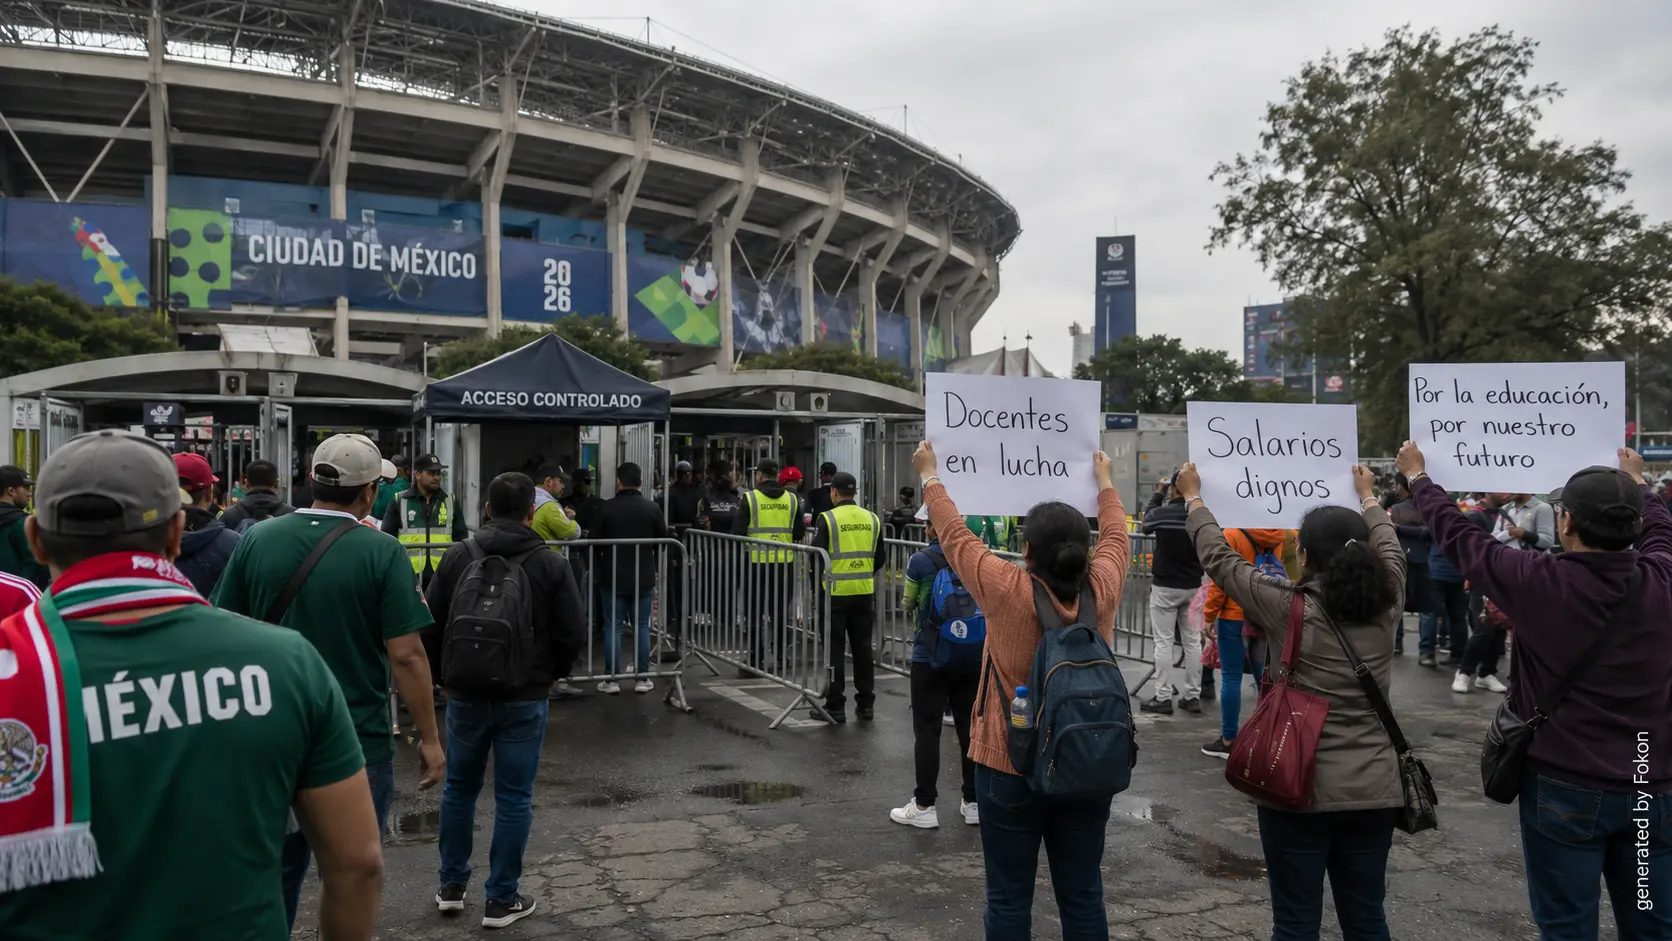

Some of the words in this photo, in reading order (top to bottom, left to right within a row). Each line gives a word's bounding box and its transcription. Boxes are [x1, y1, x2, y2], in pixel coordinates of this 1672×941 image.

[248, 234, 344, 267] CIUDAD
[352, 241, 383, 271] DE
[390, 242, 476, 279] MÉXICO
[543, 258, 571, 286] 20
[543, 284, 571, 312] 26
[460, 390, 529, 407] ACCESO
[533, 392, 642, 409] CONTROLADO
[1414, 376, 1444, 404] Por
[1453, 378, 1474, 404] la
[1485, 379, 1609, 410] educación,
[944, 391, 1069, 433] Docentes
[1430, 419, 1467, 443] por
[1482, 412, 1576, 437] nuestro
[1207, 416, 1342, 459] Salarios
[1453, 441, 1535, 468] futuro
[945, 454, 977, 474] en
[1000, 442, 1069, 478] lucha
[1235, 466, 1331, 515] dignos
